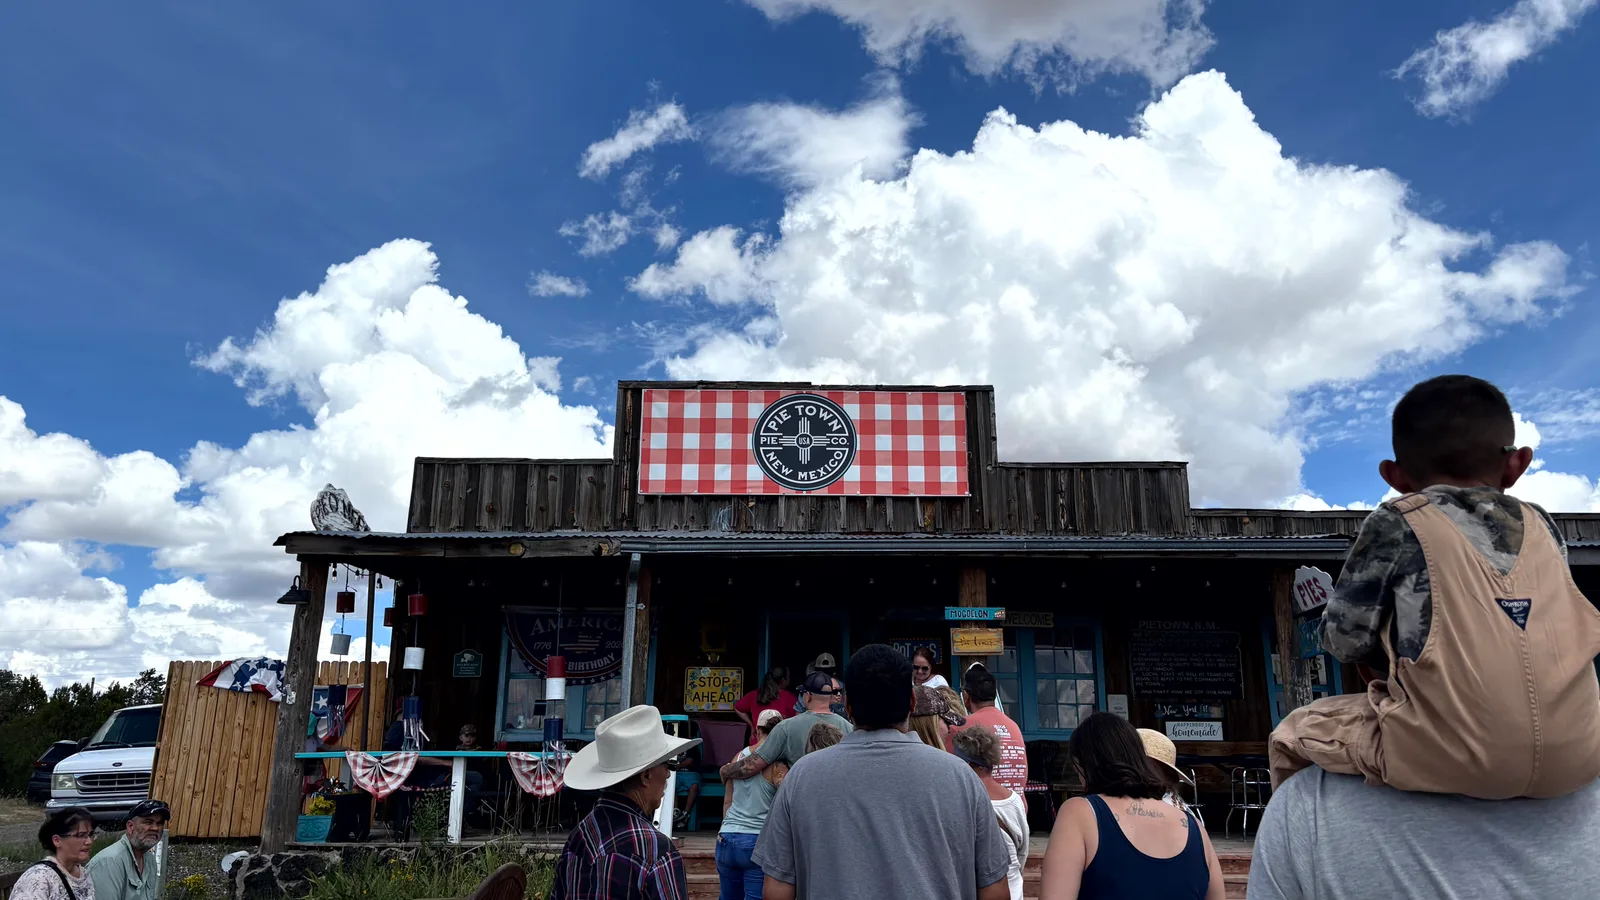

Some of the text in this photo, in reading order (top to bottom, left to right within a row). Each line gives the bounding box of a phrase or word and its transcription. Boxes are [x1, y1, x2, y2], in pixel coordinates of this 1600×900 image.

[767, 405, 842, 432] PIE TOWN
[760, 436, 850, 445] PIE USA CO.
[766, 450, 843, 481] NEW MEXICO
[1296, 576, 1328, 608] PIES
[1005, 612, 1052, 626] WELCOME
[533, 641, 552, 650] 1776
[567, 652, 616, 671] BIRTHDAY
[698, 676, 731, 688] STOP
[692, 691, 736, 703] AHEAD
[1170, 723, 1218, 738] homemade
